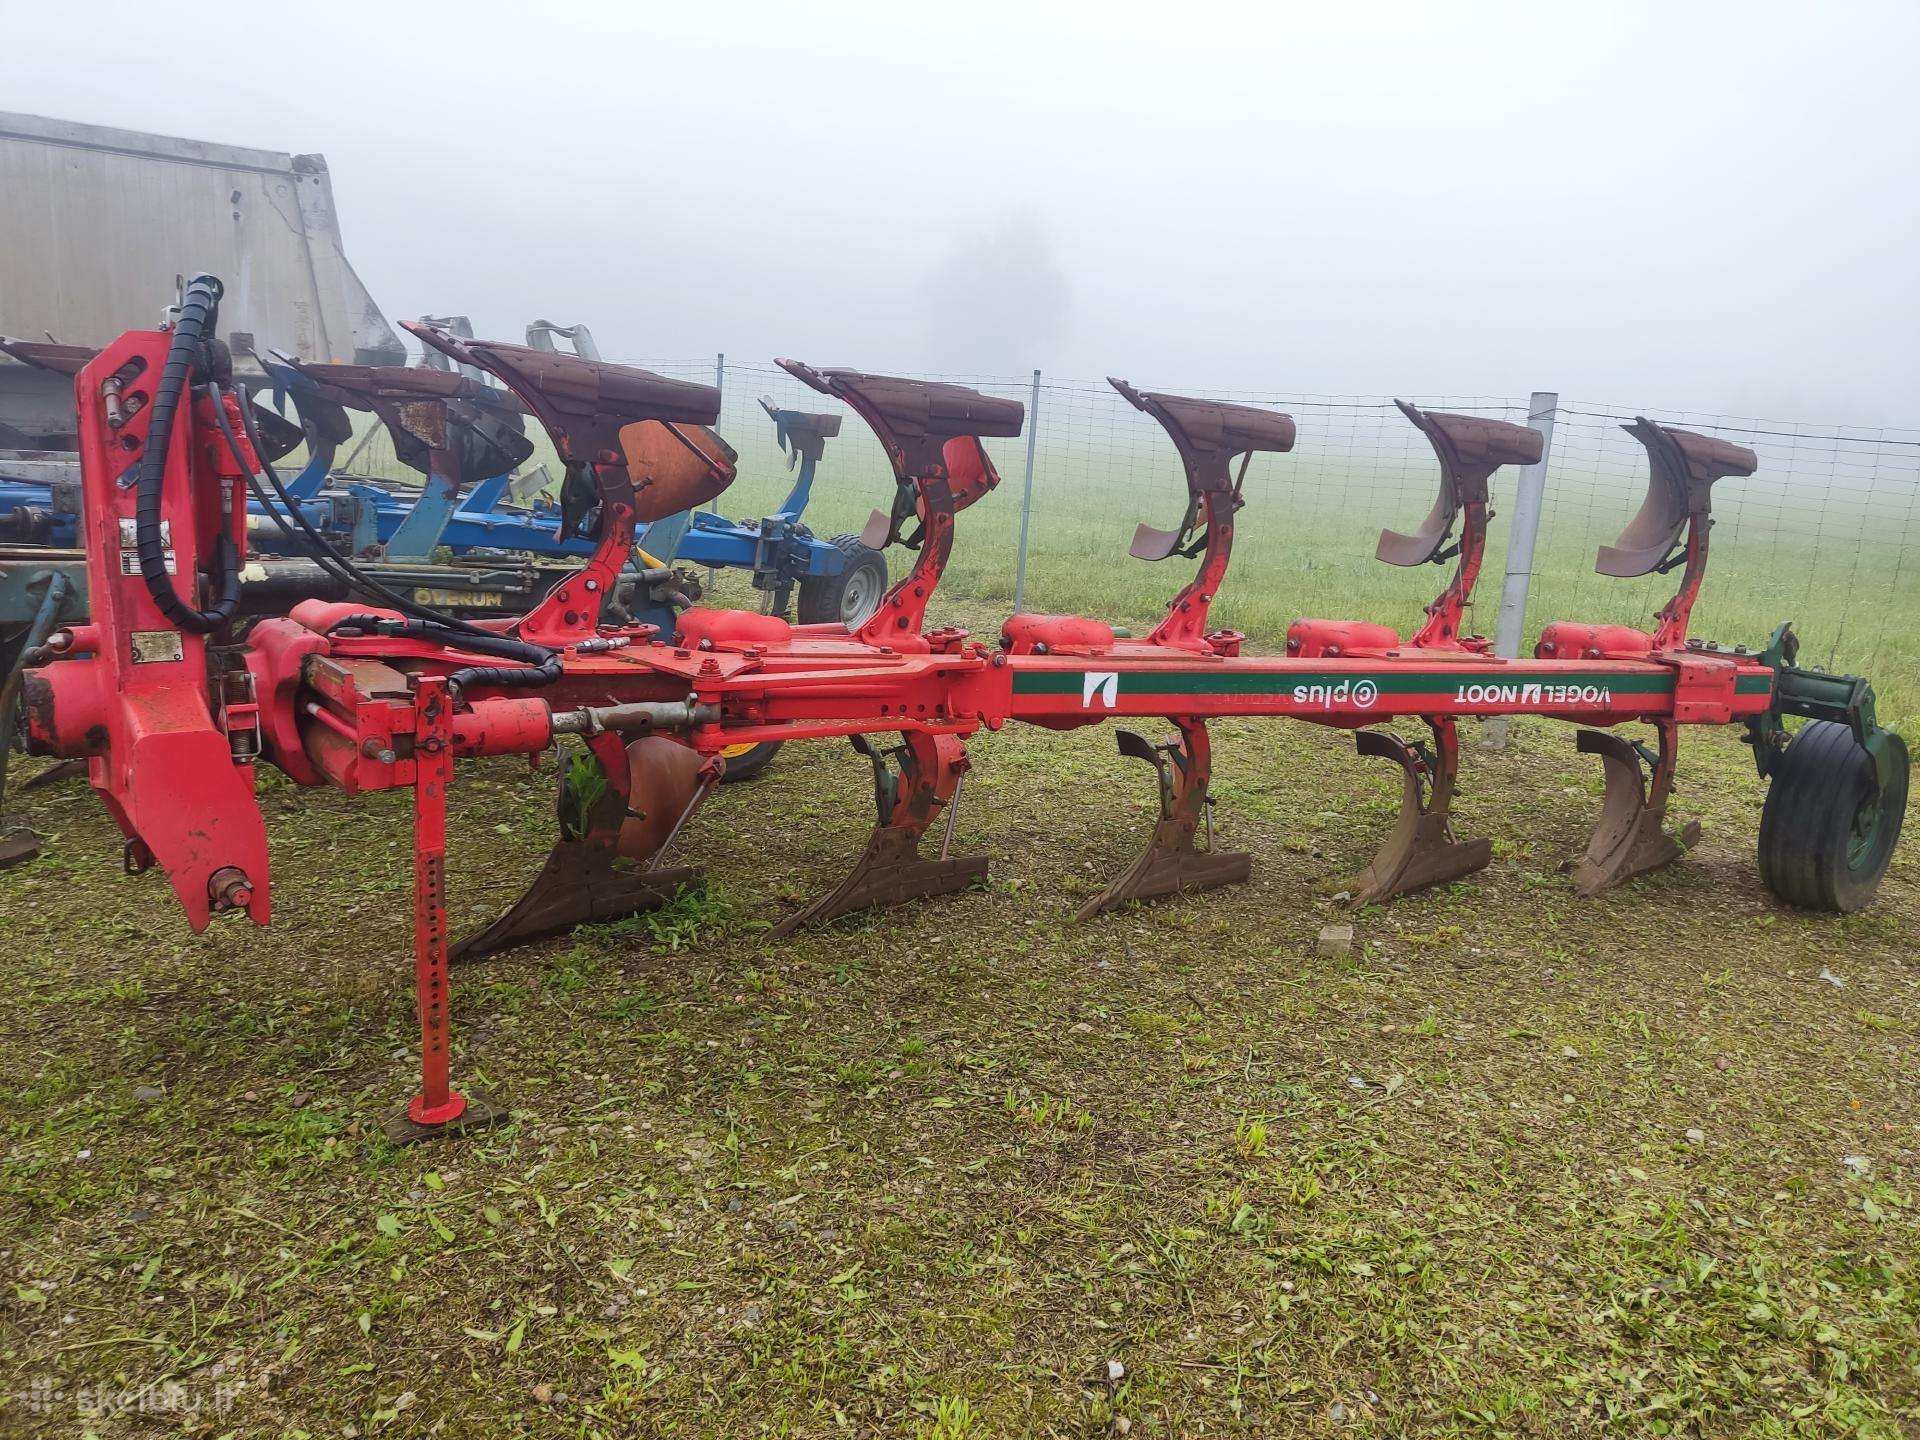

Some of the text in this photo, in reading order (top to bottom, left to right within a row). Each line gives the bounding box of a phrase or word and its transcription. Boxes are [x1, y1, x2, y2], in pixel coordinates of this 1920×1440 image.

[1293, 680, 1350, 708] plus
[1454, 684, 1611, 703] VOGEL NOOT
